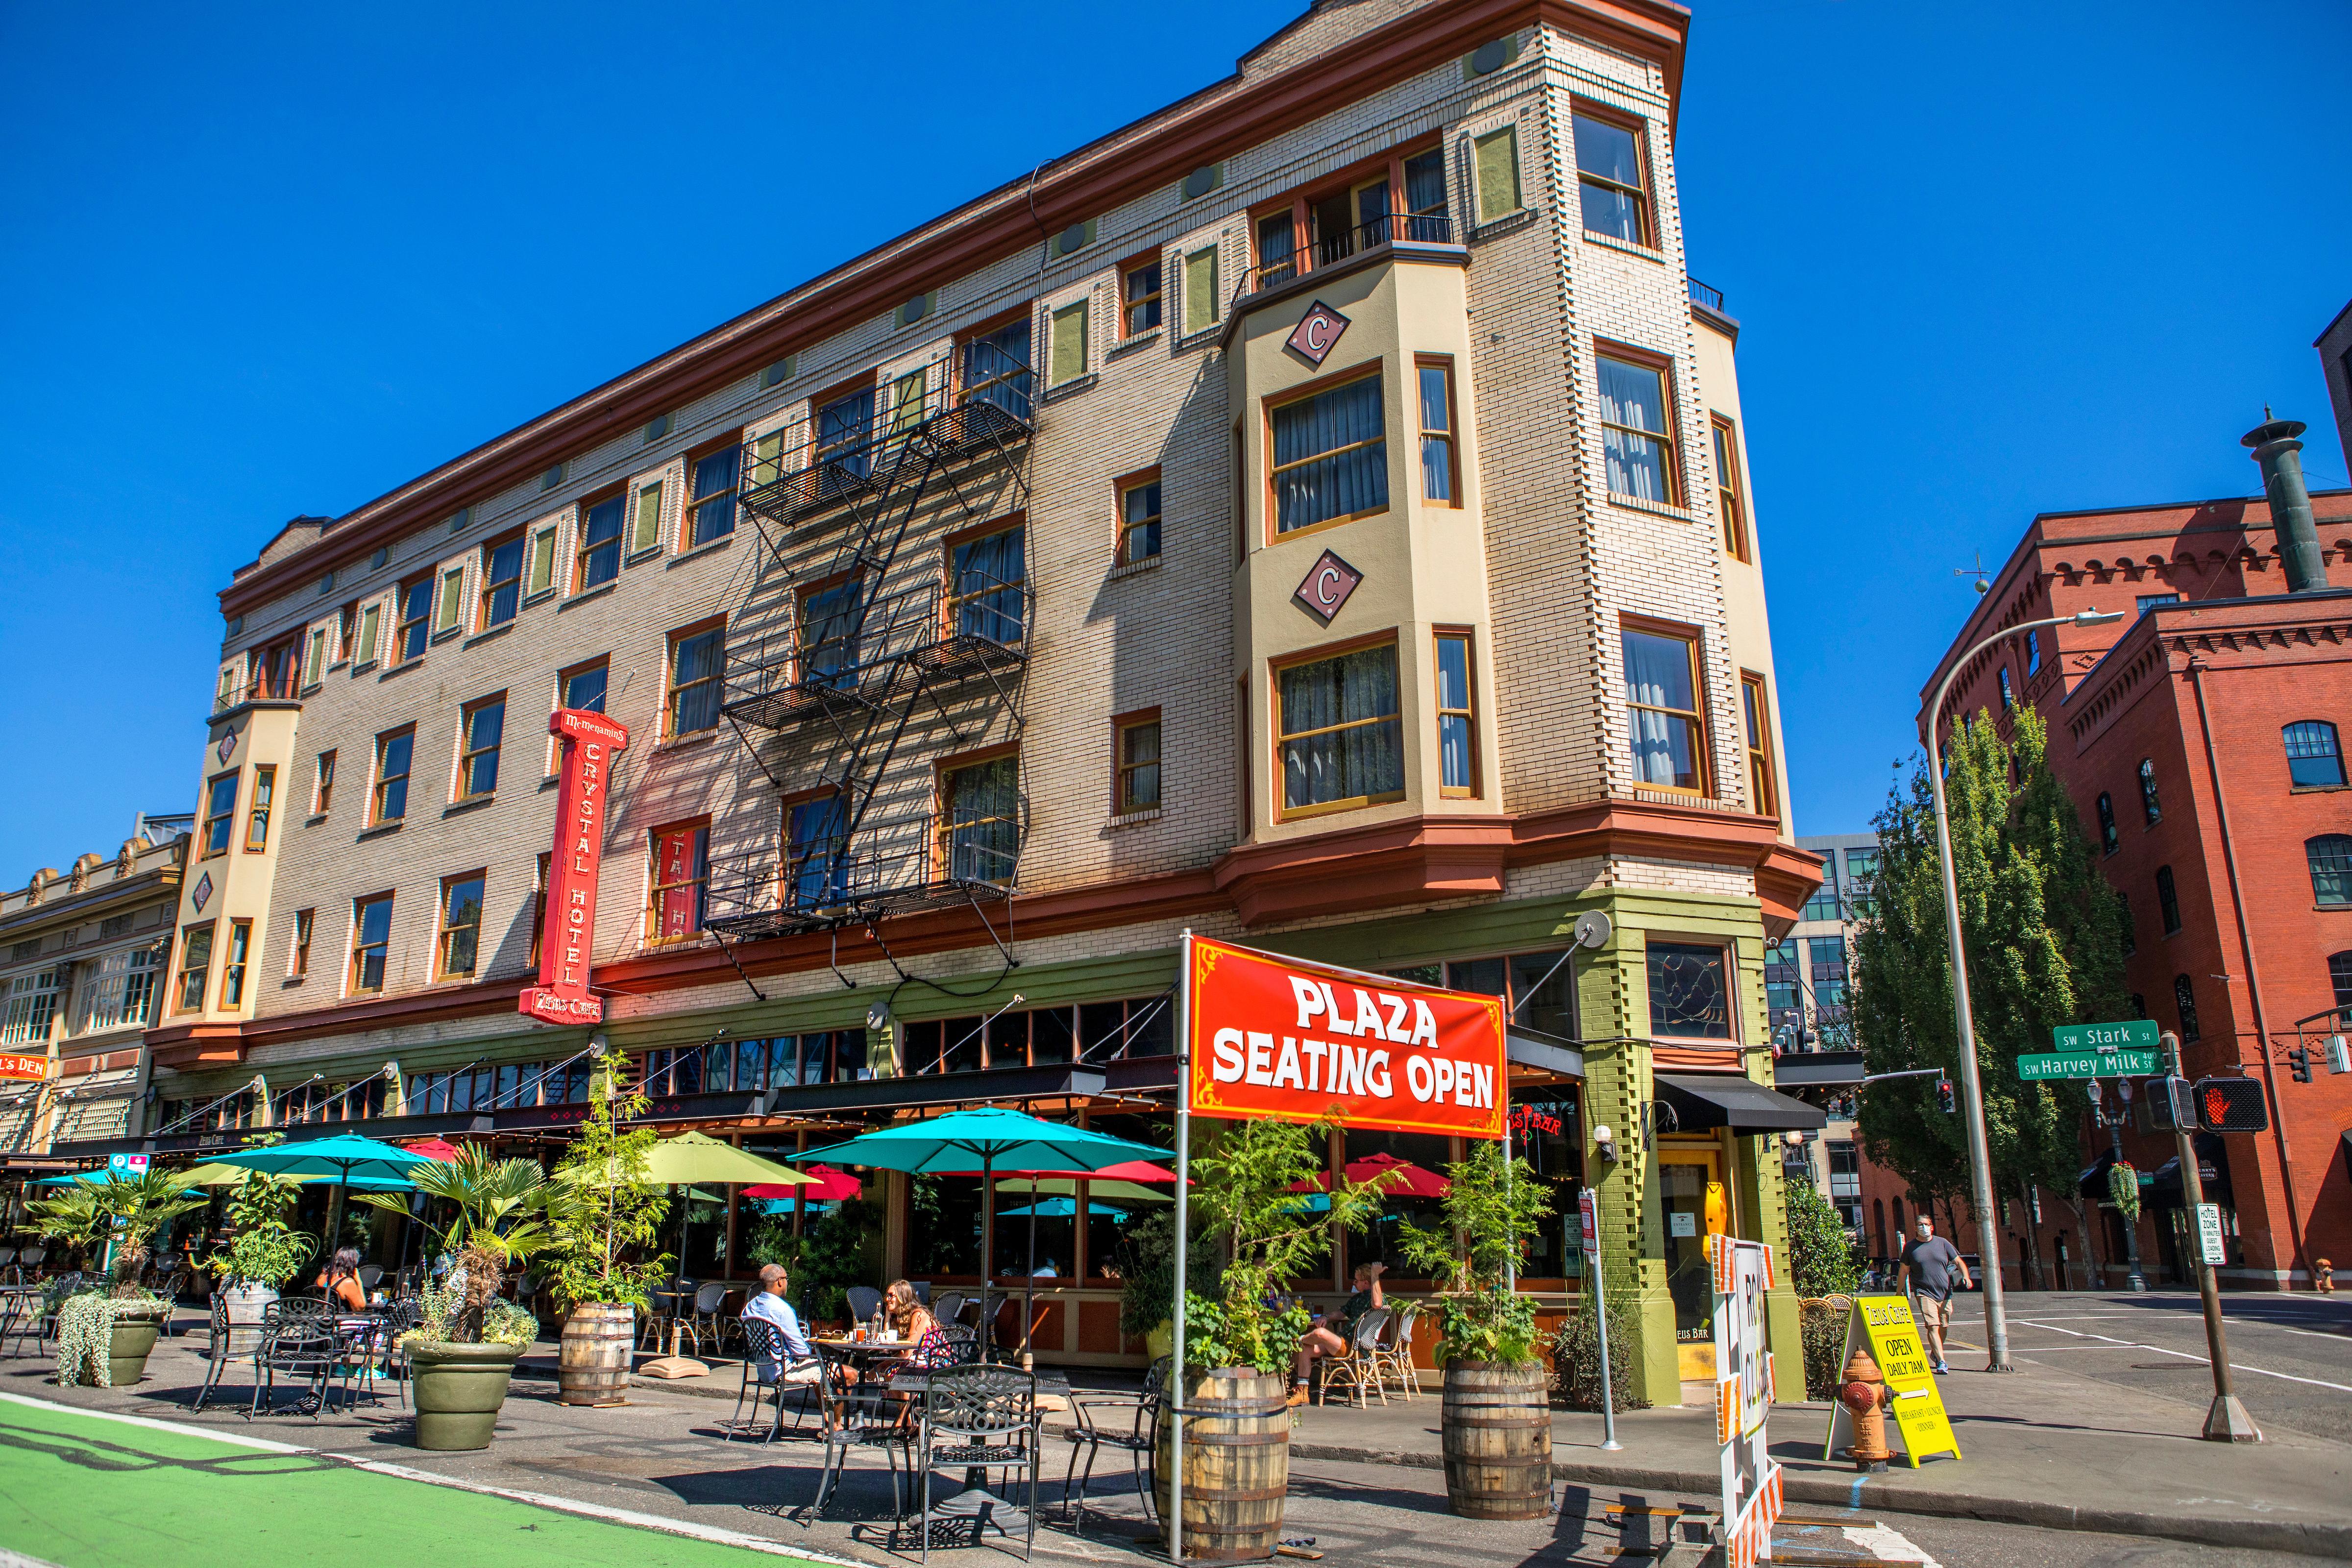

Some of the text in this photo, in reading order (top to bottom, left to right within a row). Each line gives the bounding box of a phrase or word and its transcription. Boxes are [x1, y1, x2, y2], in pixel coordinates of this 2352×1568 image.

[1307, 316, 1329, 351] C
[1317, 567, 1341, 606] C
[563, 743, 601, 984] CRYSTAL HOTEL
[1288, 976, 1439, 1049] PLAZA
[2064, 1027, 2151, 1045] SW Stark St
[2143, 1052, 2157, 1060] 400
[2328, 1046, 2334, 1054] NO
[1213, 1028, 1494, 1110] SEATING OPEN
[2025, 1054, 2152, 1075] SW Harvey Milk St
[1532, 1112, 1562, 1136] BAR
[2200, 1209, 2217, 1219] HOTEL
[2203, 1220, 2217, 1228] ZONE
[1865, 1303, 1911, 1326] ZEUS CAFE
[1692, 1328, 1709, 1339] BAR
[1886, 1339, 1913, 1356] OPEN
[1886, 1360, 1925, 1376] DAILY 7AM
[1900, 1406, 1942, 1421] BREAKFAST LUNCH
[1917, 1421, 1936, 1432] DINNER
